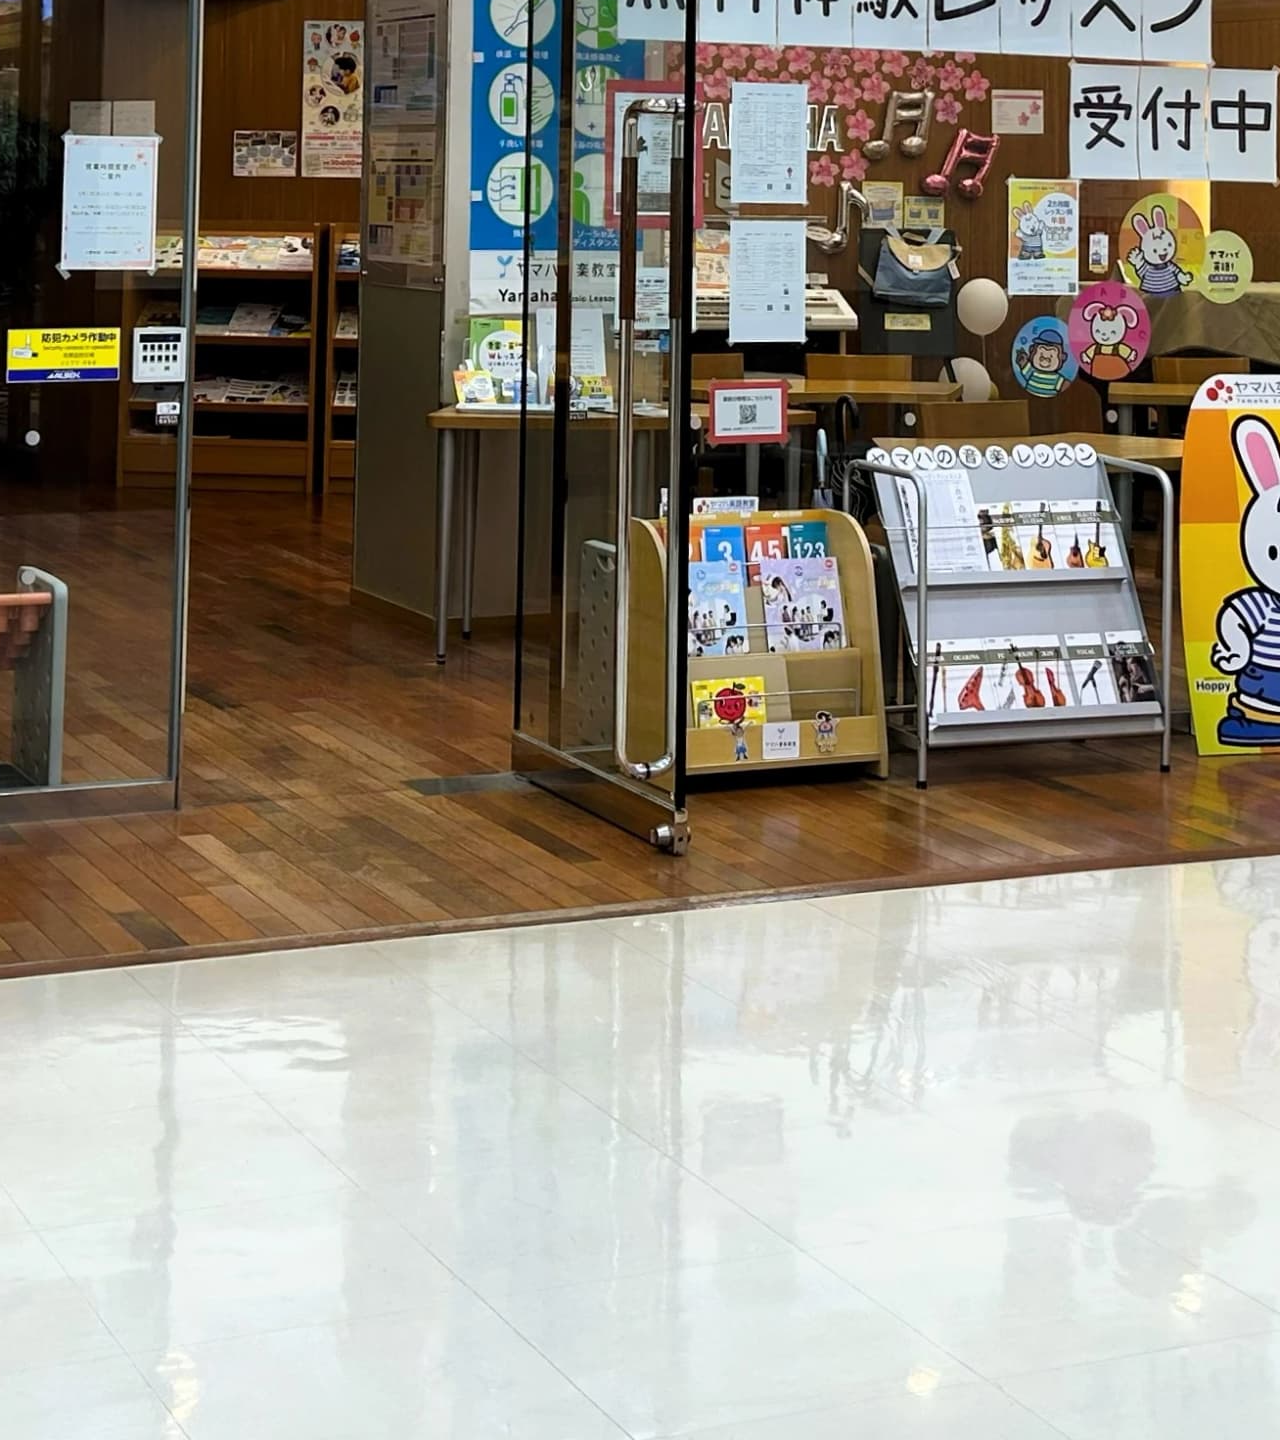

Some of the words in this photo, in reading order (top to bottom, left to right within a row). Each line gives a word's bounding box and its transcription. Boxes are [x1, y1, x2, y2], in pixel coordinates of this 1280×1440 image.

[1073, 85, 1272, 153] 受付中
[517, 263, 618, 279] ヤマハ楽教室
